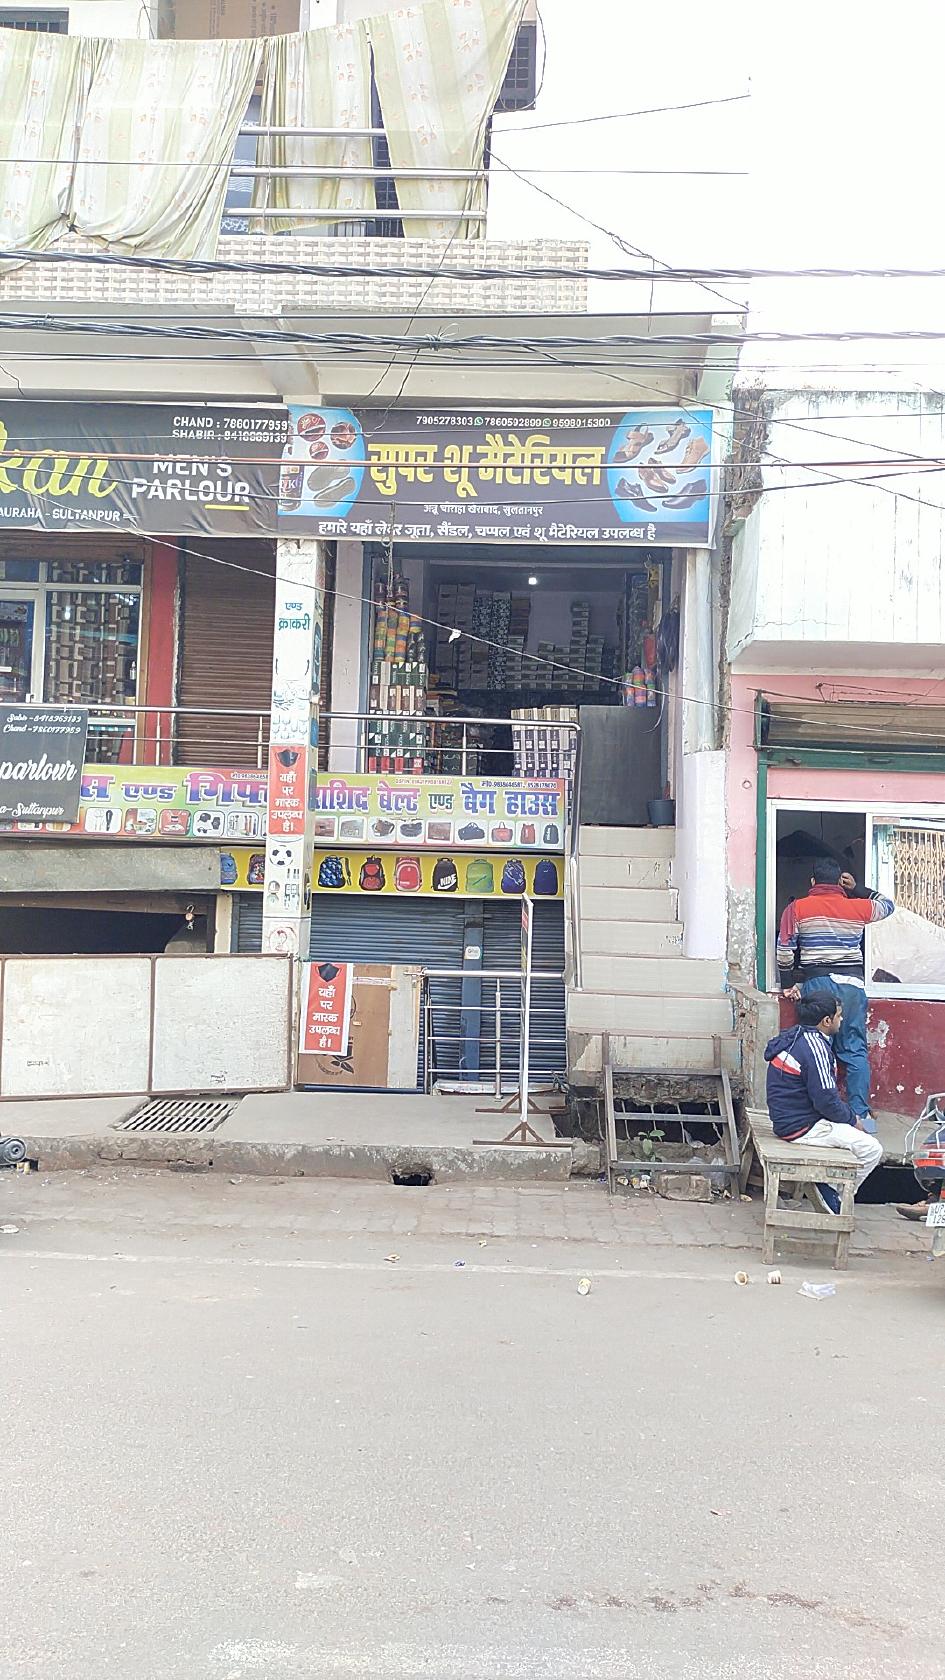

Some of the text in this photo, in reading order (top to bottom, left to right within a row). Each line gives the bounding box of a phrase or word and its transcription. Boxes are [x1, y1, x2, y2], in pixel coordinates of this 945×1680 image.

[173, 416, 214, 428] CHAND
[223, 418, 288, 430] 7860177959
[416, 416, 473, 425] 7905278303
[485, 417, 546, 427] 7860592899
[367, 443, 438, 496] सुपर
[443, 445, 478, 498] शू
[131, 478, 250, 502] PARLOUR
[52, 508, 121, 521] SULTANPUR
[318, 518, 348, 535] हमारे
[350, 518, 373, 535] यहाँ
[404, 523, 434, 539] जूता,
[475, 525, 511, 538] चप्पल
[513, 523, 531, 538] एवं
[533, 526, 549, 542] शू
[548, 522, 599, 539] मैटेरियल
[601, 526, 646, 539] उपलब्ध
[647, 523, 656, 540] है
[0, 753, 78, 781] parlour
[279, 770, 297, 783] यहाँ
[282, 786, 294, 796] पर
[460, 782, 497, 815] बैग
[504, 790, 561, 816] हाउस
[318, 984, 336, 998] यहाँ
[320, 1000, 333, 1010] पर
[934, 1203, 945, 1214] UP
